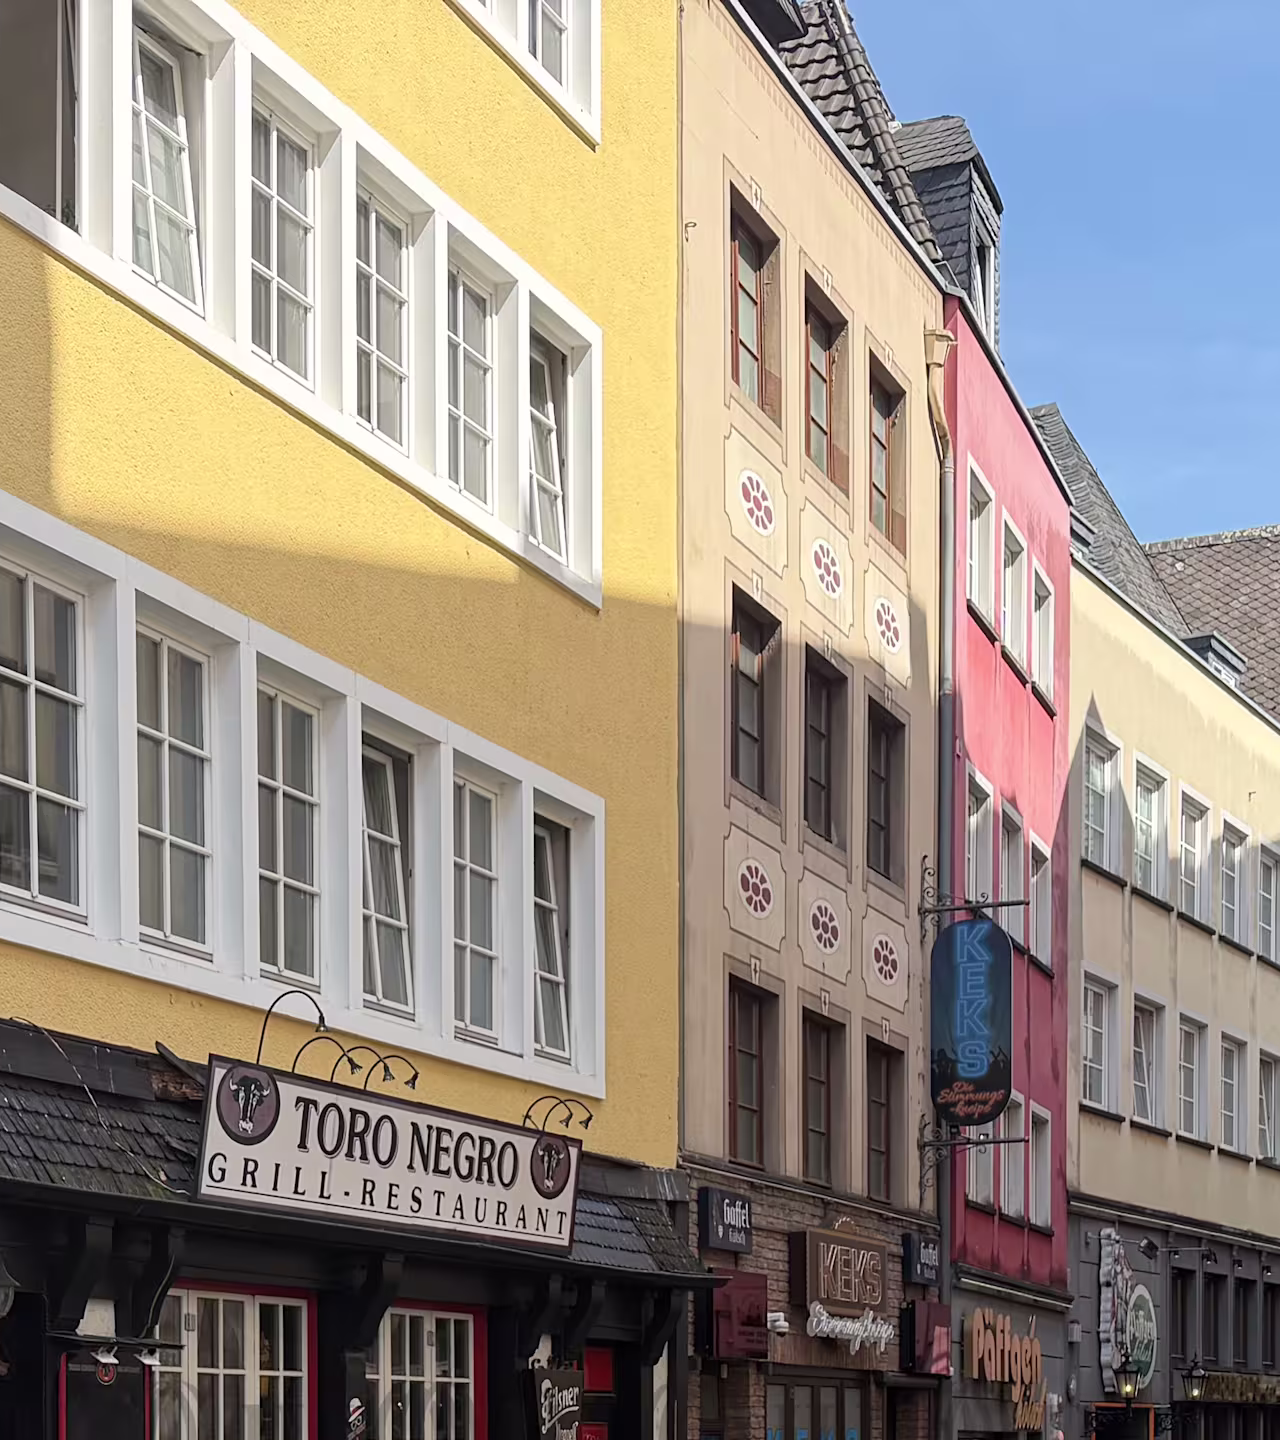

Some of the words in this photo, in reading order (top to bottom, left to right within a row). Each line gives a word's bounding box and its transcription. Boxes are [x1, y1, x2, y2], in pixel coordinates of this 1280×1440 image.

[956, 923, 991, 1078] KEKS
[294, 1096, 399, 1168] TORO
[406, 1122, 519, 1190] NEGRO
[723, 1198, 750, 1229] Gaffel
[819, 1242, 883, 1305] KEKS
[920, 1241, 939, 1266] Gaffel
[972, 1306, 1043, 1403] Päffgen
[540, 1378, 580, 1434] Pilsner
